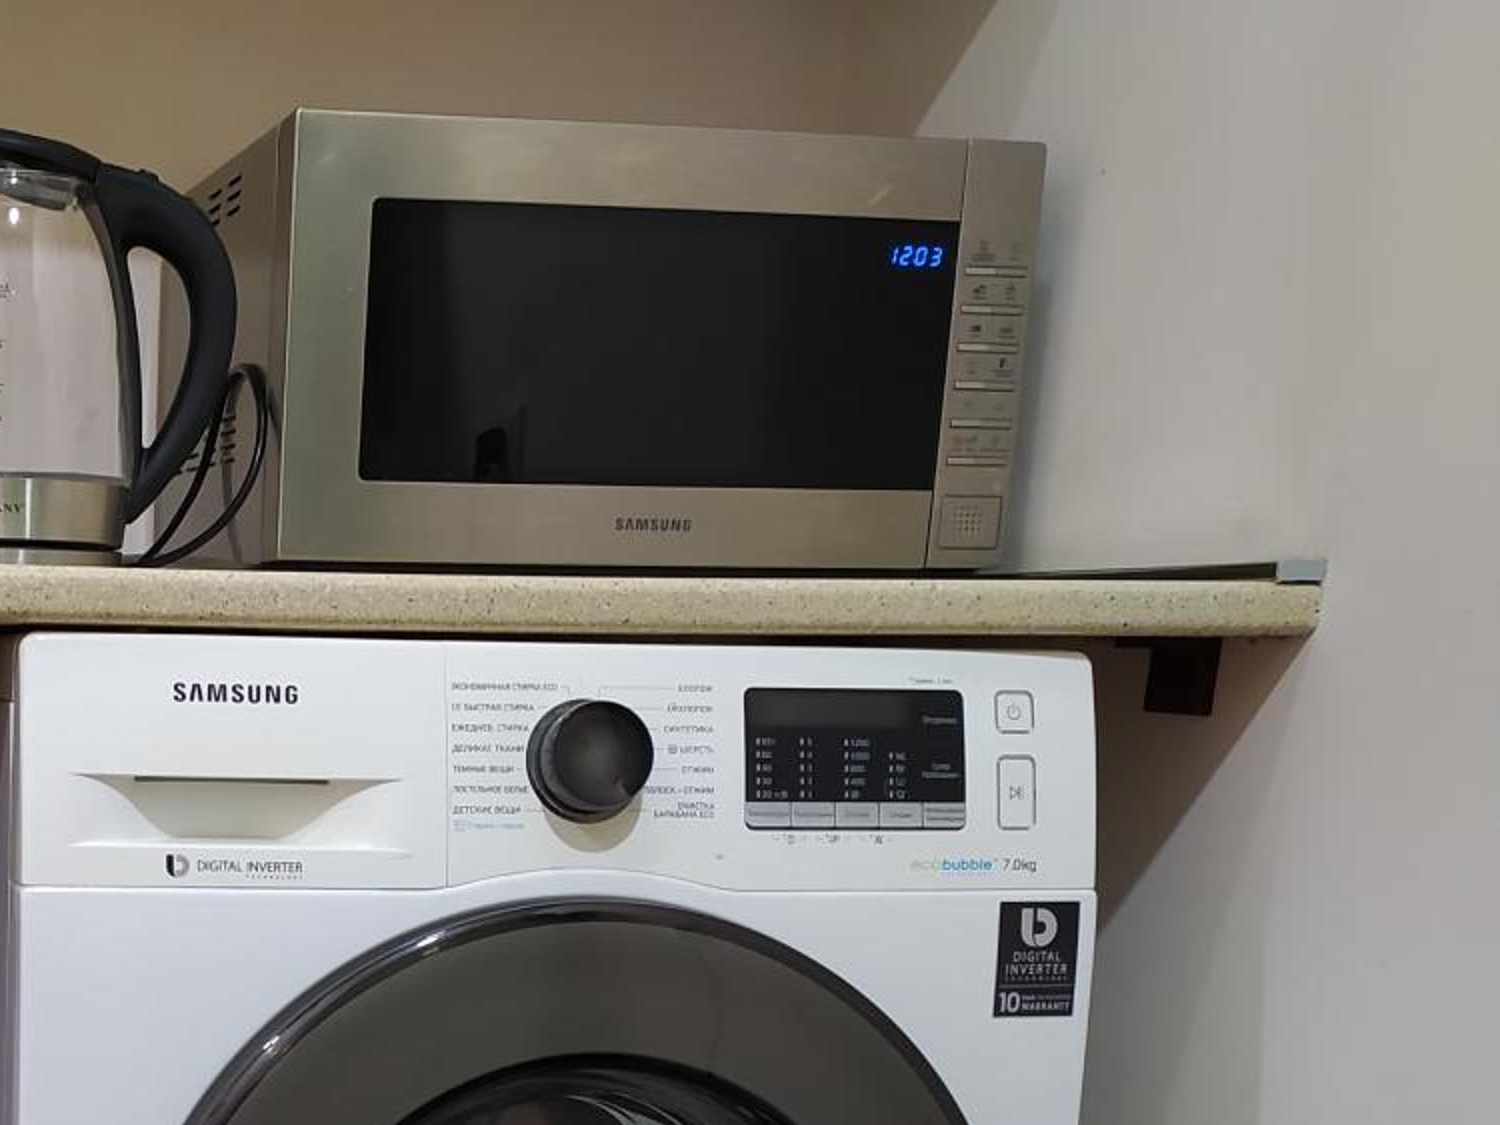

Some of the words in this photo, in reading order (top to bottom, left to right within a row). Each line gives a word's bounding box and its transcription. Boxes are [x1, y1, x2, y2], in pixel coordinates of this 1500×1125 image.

[615, 517, 692, 532] SAMSUNG
[172, 682, 300, 704] SAMSUNG
[197, 859, 243, 873] DIGITAL
[245, 861, 303, 874] INVERTER
[1012, 950, 1061, 963] DIGITAL
[1005, 963, 1068, 975] INVERTER
[998, 991, 1021, 1014] 10
